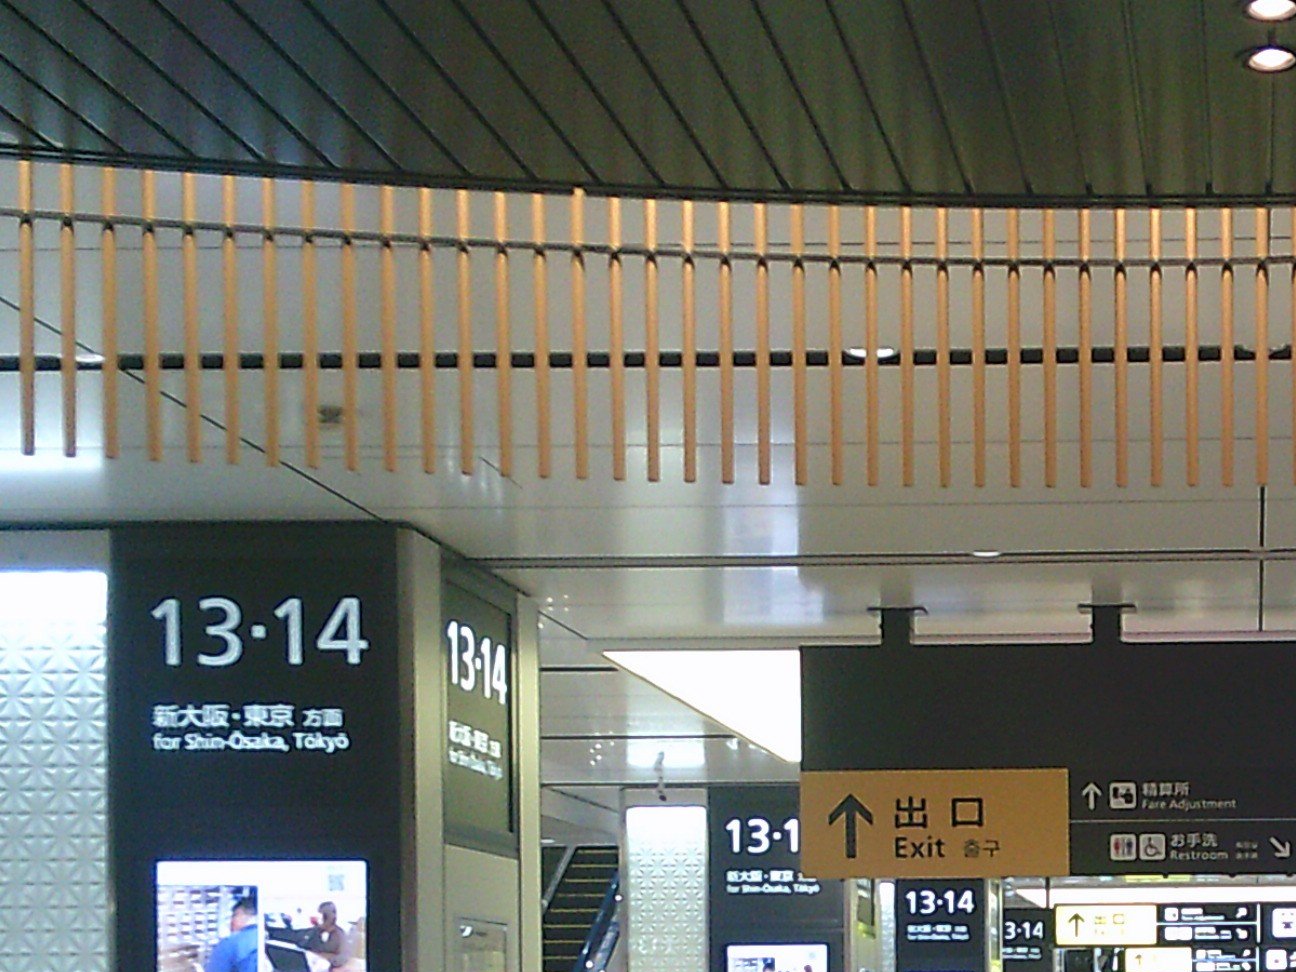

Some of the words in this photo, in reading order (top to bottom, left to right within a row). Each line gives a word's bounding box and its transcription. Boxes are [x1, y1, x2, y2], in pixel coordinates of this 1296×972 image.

[301, 707, 343, 728] 方面
[152, 732, 180, 751] for
[1141, 799, 1168, 810] Fare
[1169, 798, 1237, 812] Adjustment
[725, 818, 800, 854] 13·1
[894, 835, 946, 859] Exit
[1169, 850, 1229, 861] Restroom
